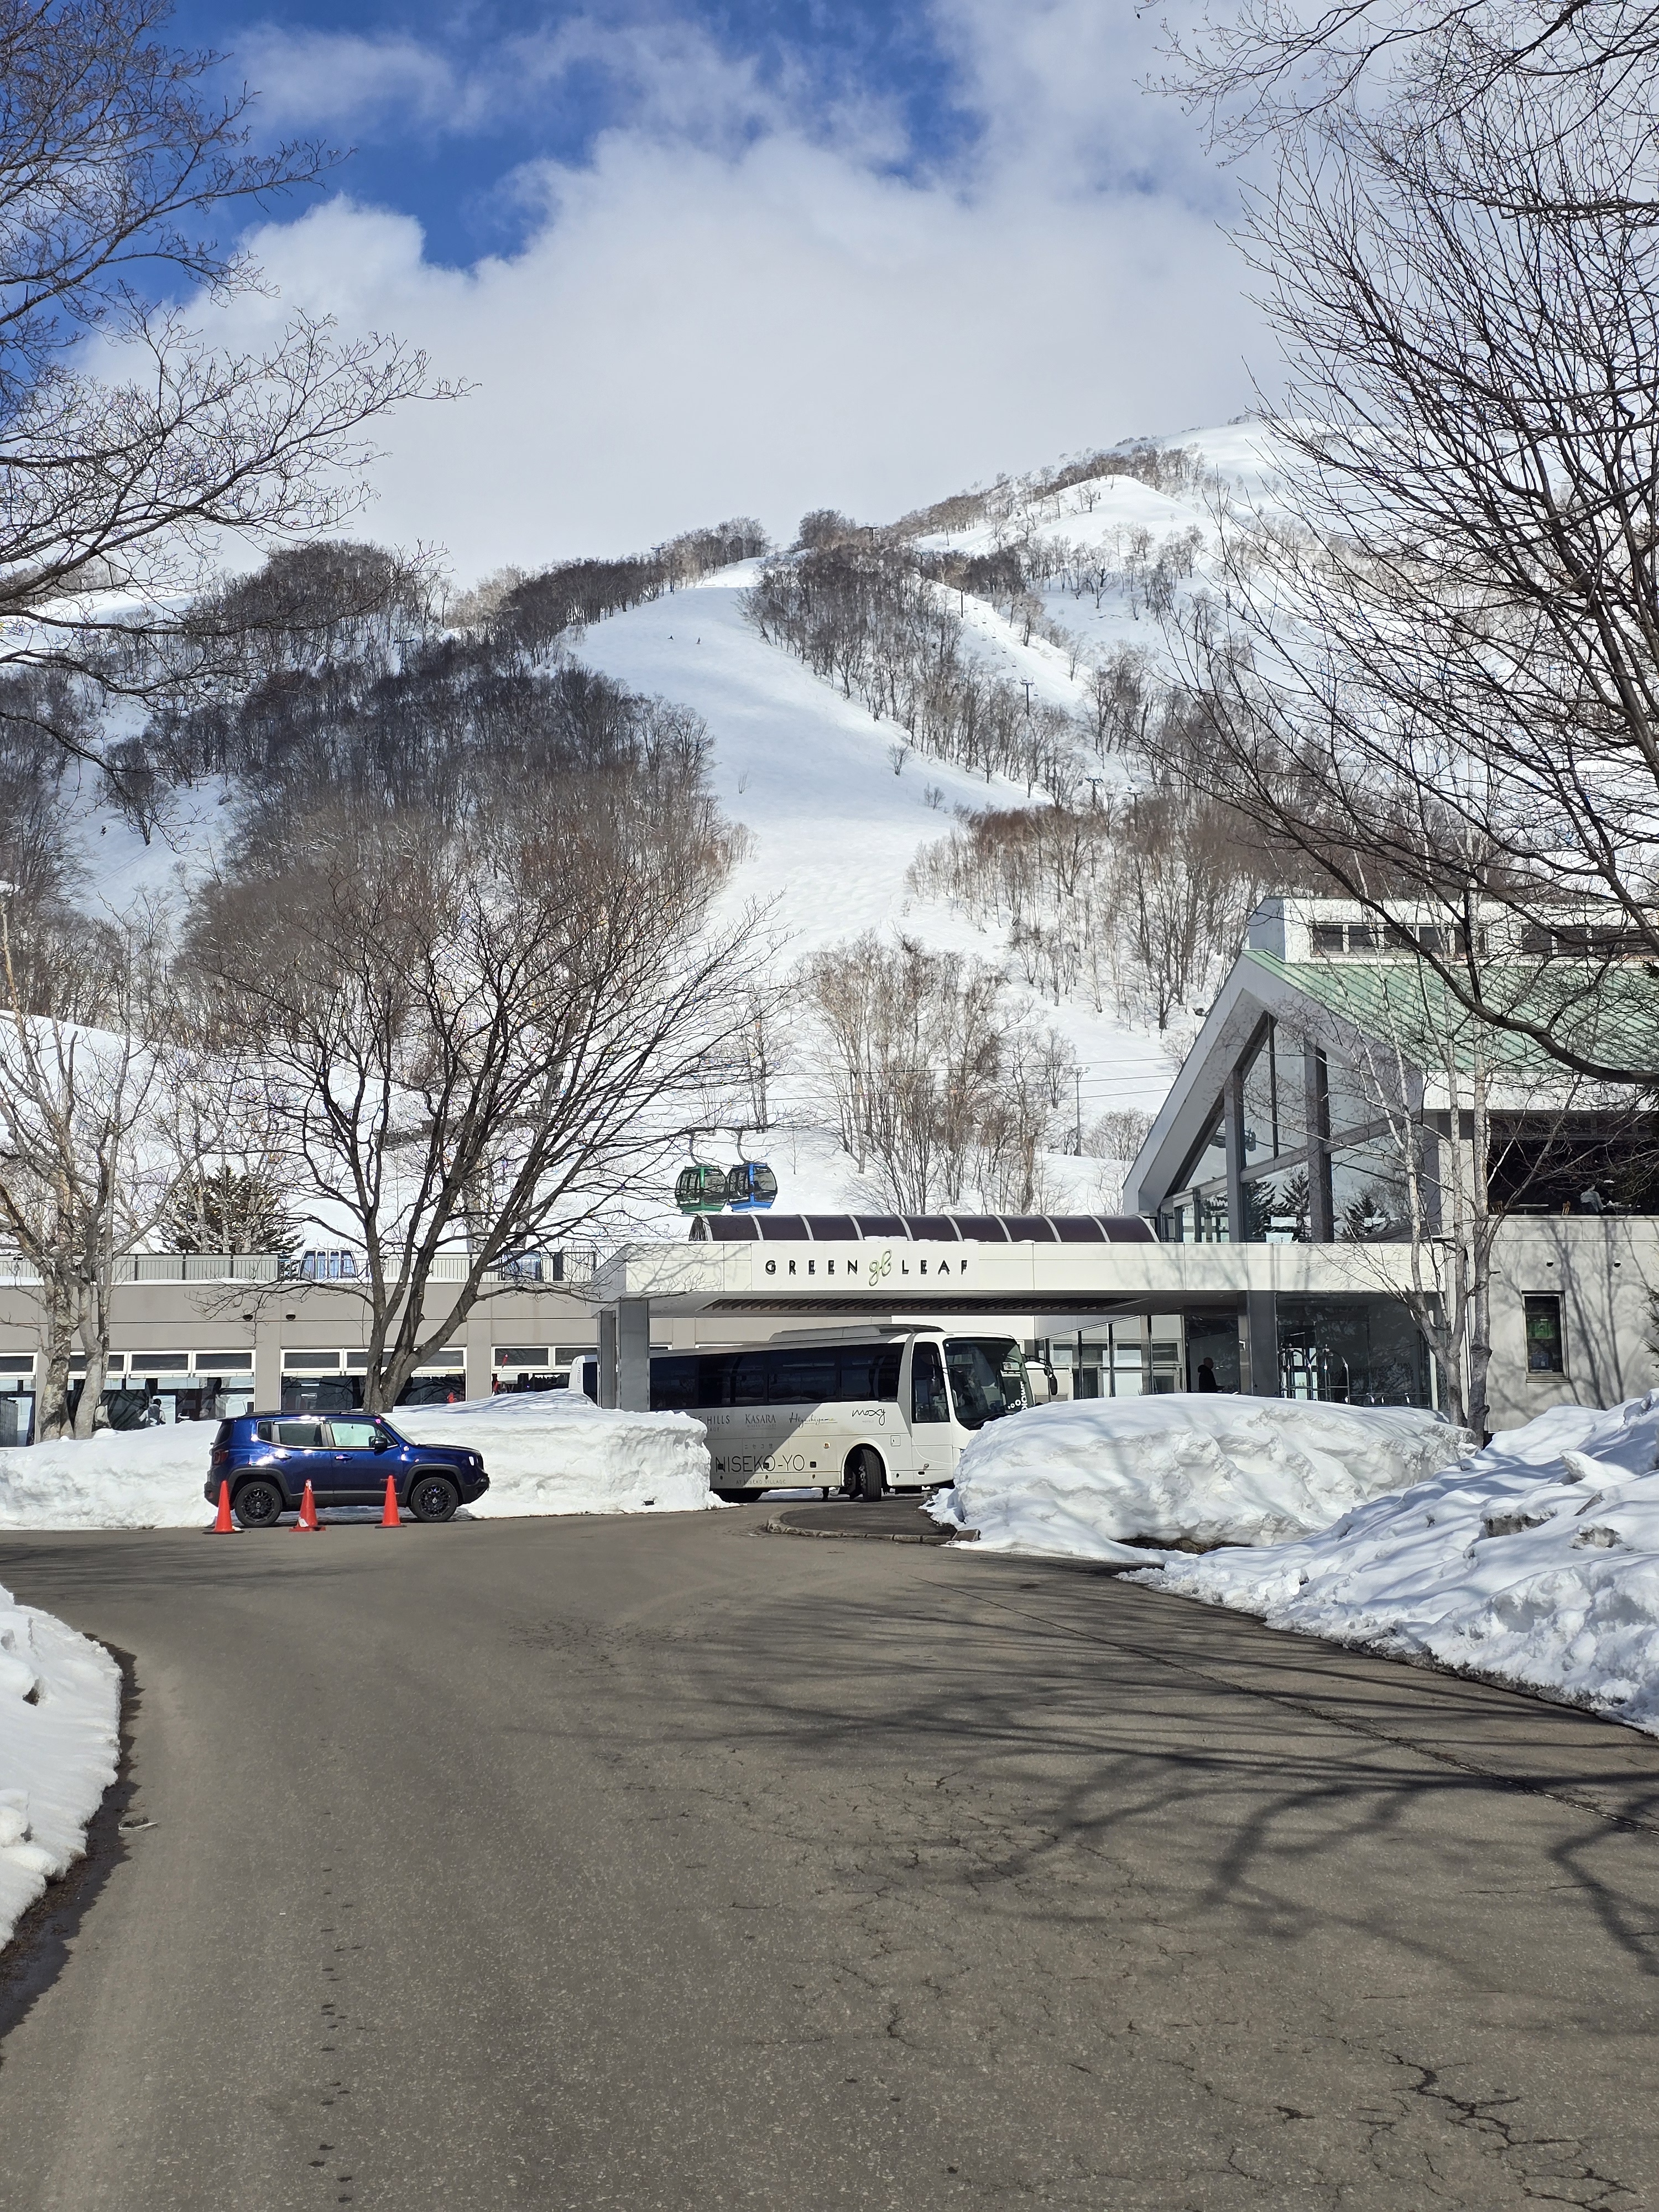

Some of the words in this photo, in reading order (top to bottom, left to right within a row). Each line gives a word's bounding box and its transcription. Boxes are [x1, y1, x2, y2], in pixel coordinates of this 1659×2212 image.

[765, 1260, 858, 1275] GREEN
[901, 1260, 968, 1275] LEAF
[707, 1415, 731, 1425] HILLS
[745, 1413, 776, 1424] KASARA
[715, 1454, 805, 1473] NISEKO-YO
